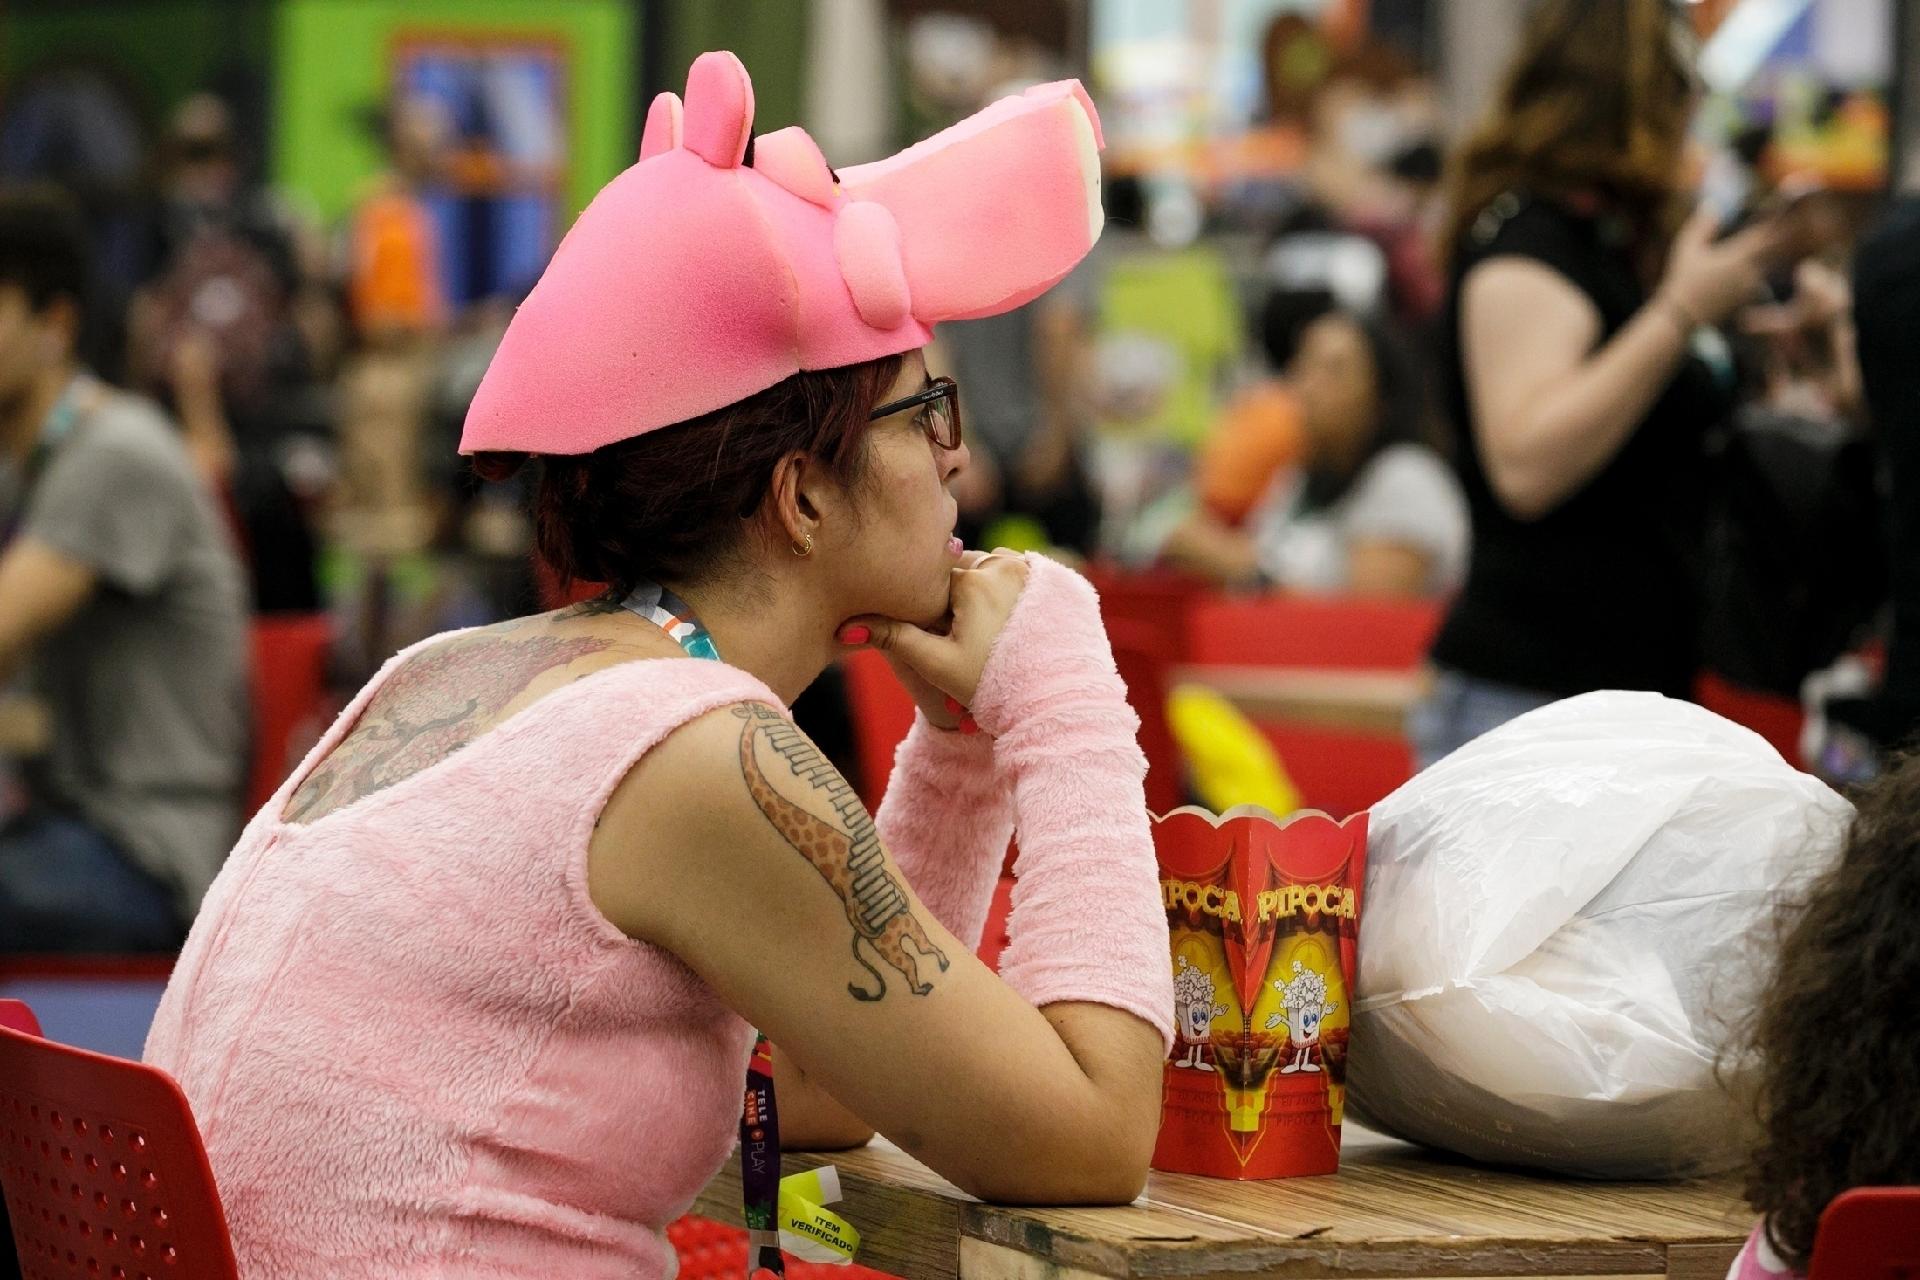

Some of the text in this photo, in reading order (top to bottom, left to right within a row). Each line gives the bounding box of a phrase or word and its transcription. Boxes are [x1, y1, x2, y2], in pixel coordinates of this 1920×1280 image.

[1160, 880, 1243, 924] IPOCA
[1257, 883, 1357, 924] PIPOCA
[747, 1091, 757, 1126] CINE
[757, 1089, 768, 1122] TELE
[750, 1141, 767, 1175] PLAY
[791, 1218, 853, 1252] VERIFICADO
[815, 1215, 841, 1234] ITEM
